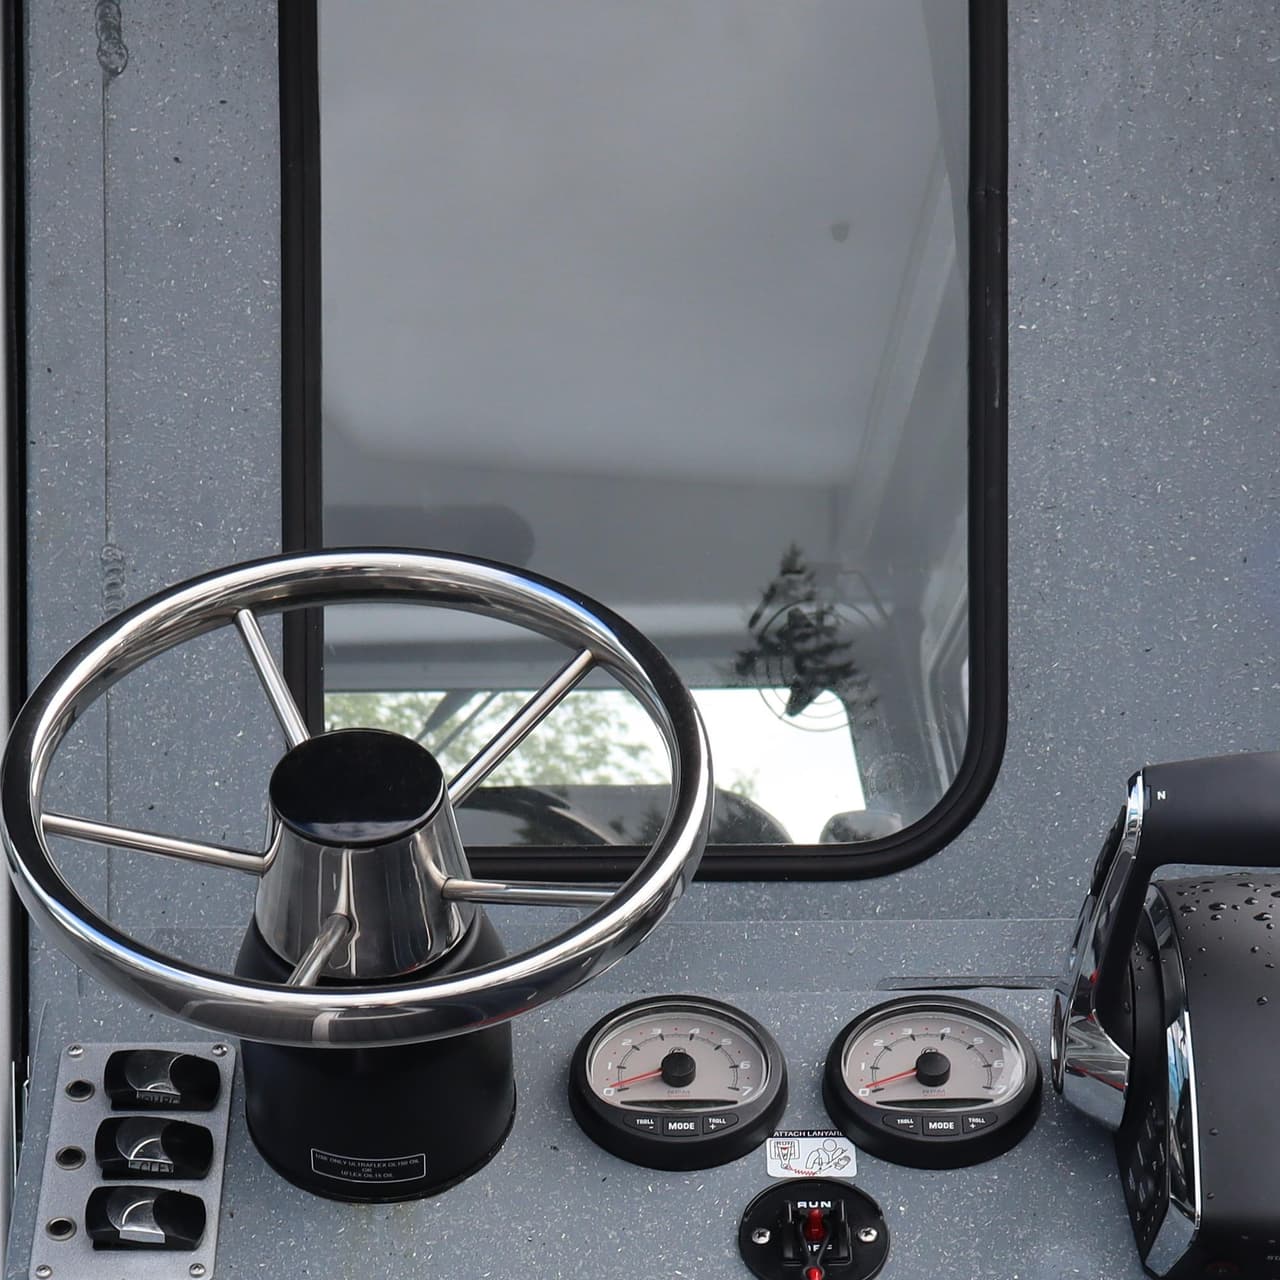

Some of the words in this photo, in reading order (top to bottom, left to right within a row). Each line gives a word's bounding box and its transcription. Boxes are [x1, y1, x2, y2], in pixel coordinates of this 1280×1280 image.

[1157, 790, 1166, 800] N
[621, 1038, 632, 1046] 2
[720, 1038, 732, 1046] 5
[873, 1039, 884, 1047] 2
[972, 1036, 984, 1044] 5
[607, 1062, 612, 1070] 1
[740, 1061, 751, 1069] 6
[860, 1062, 866, 1071] 1
[994, 1059, 1005, 1068] 6
[603, 1087, 615, 1096] 0
[742, 1087, 753, 1096] 7
[858, 1088, 870, 1096] 0
[668, 1122, 695, 1130] MODE
[807, 1244, 833, 1252] FF
